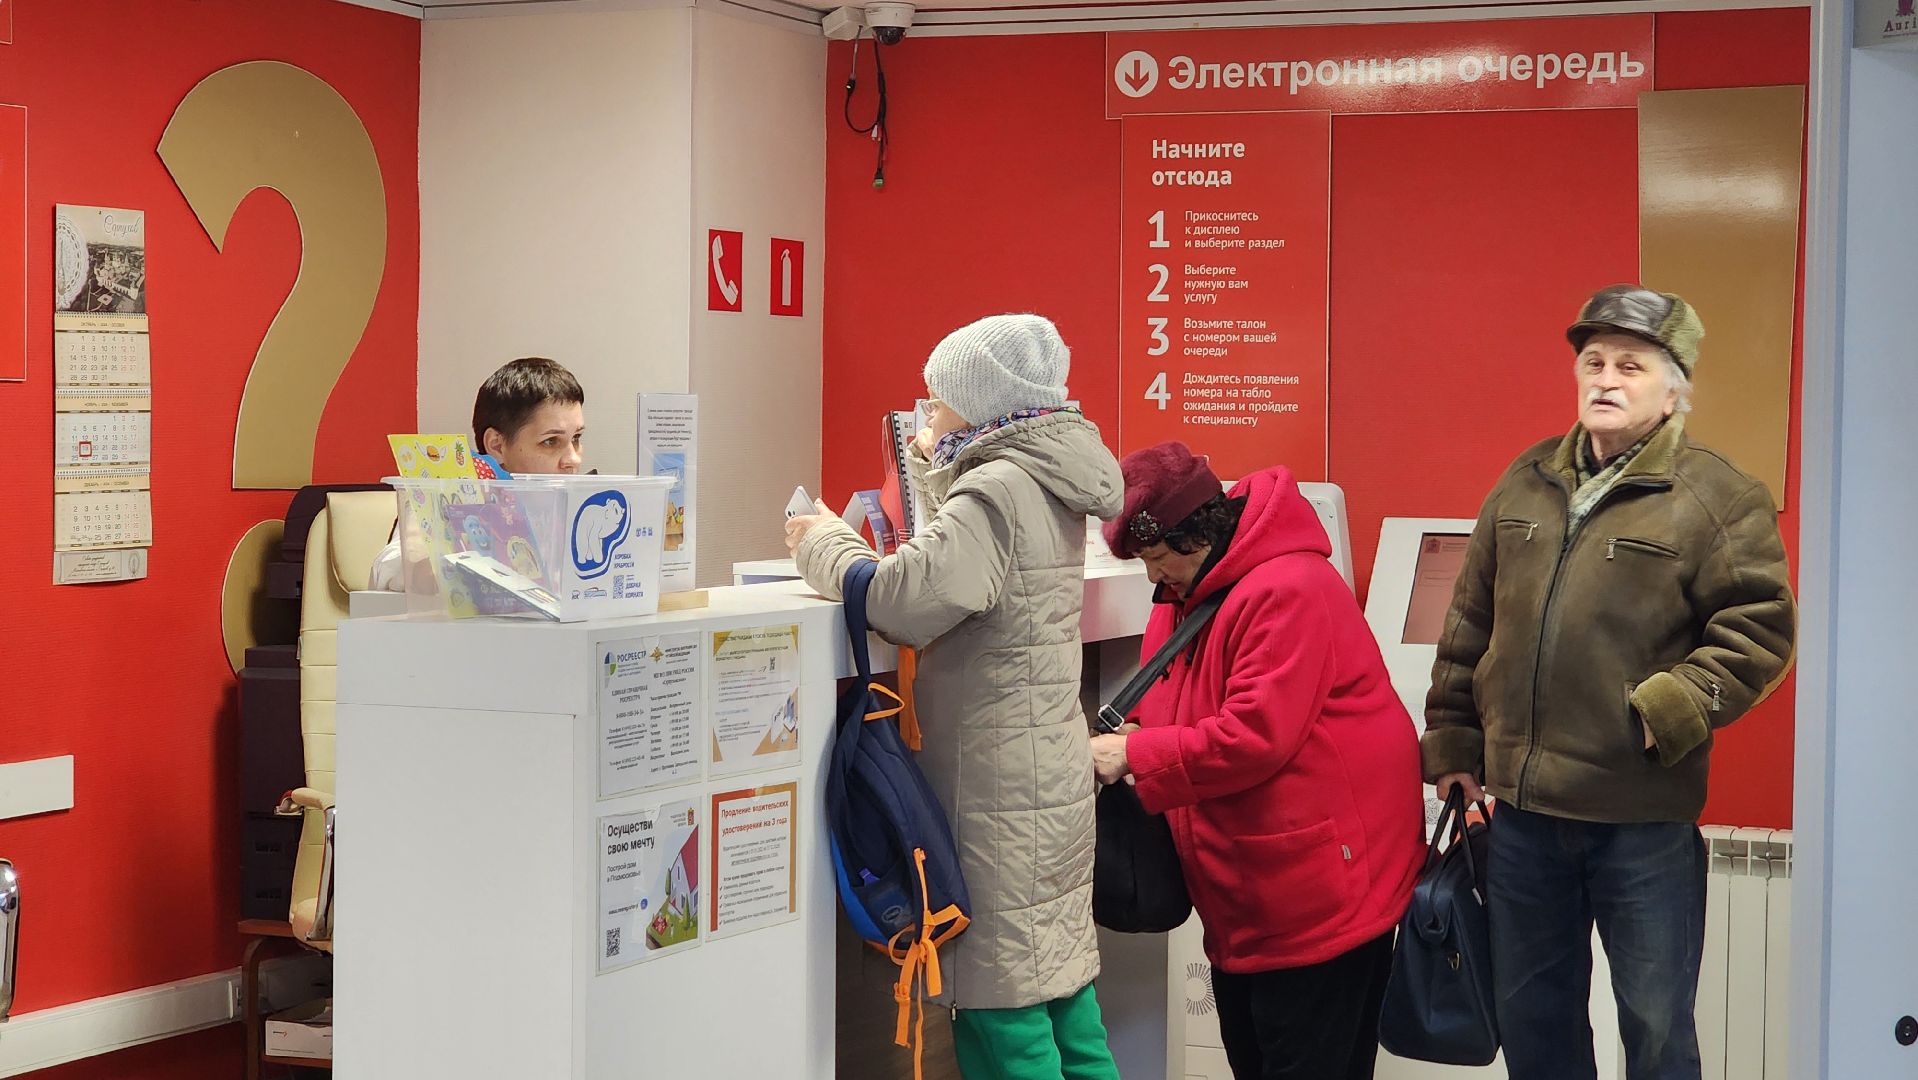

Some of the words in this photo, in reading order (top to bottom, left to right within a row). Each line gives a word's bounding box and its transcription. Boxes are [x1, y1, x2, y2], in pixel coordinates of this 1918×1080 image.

[1168, 55, 1441, 95] Электронная
[1458, 50, 1645, 89] очередь
[1153, 140, 1246, 159] Начните
[1152, 170, 1232, 189] отсюда
[1186, 211, 1259, 223] Прикоснитесь
[1148, 211, 1169, 247] 1
[1185, 227, 1192, 235] к
[1193, 226, 1240, 238] дисплею
[1185, 239, 1192, 249] и
[1195, 238, 1246, 251] выберите
[1249, 240, 1285, 251] раздел
[1185, 264, 1237, 277] Выберите
[1147, 264, 1169, 301] 2
[1185, 281, 1226, 292] нужную
[1229, 281, 1249, 289] вам
[1184, 294, 1218, 305] услугу
[1184, 318, 1234, 329] Возьмите
[1236, 321, 1267, 329] талон
[1148, 318, 1169, 355] 3
[1184, 334, 1190, 342] с
[1193, 334, 1241, 345] номером
[1244, 333, 1277, 343] вашей
[1184, 348, 1228, 359] очереди
[1183, 373, 1242, 386] Дождитесь
[1244, 376, 1300, 385] появления
[1144, 372, 1171, 410] 4
[1184, 389, 1223, 400] номера
[1226, 389, 1239, 398] на
[1241, 387, 1272, 399] табло
[1183, 402, 1236, 412] ожидания
[1239, 403, 1246, 411] и
[1249, 401, 1299, 414] пройдите
[1184, 416, 1190, 424] к
[1192, 416, 1259, 428] специалисту
[616, 650, 647, 663] РОСРЕЕСТР
[721, 807, 751, 818] Продление
[752, 800, 789, 812] водительских
[607, 820, 653, 838] Осуществи
[607, 840, 629, 855] свою
[630, 836, 655, 849] мечту
